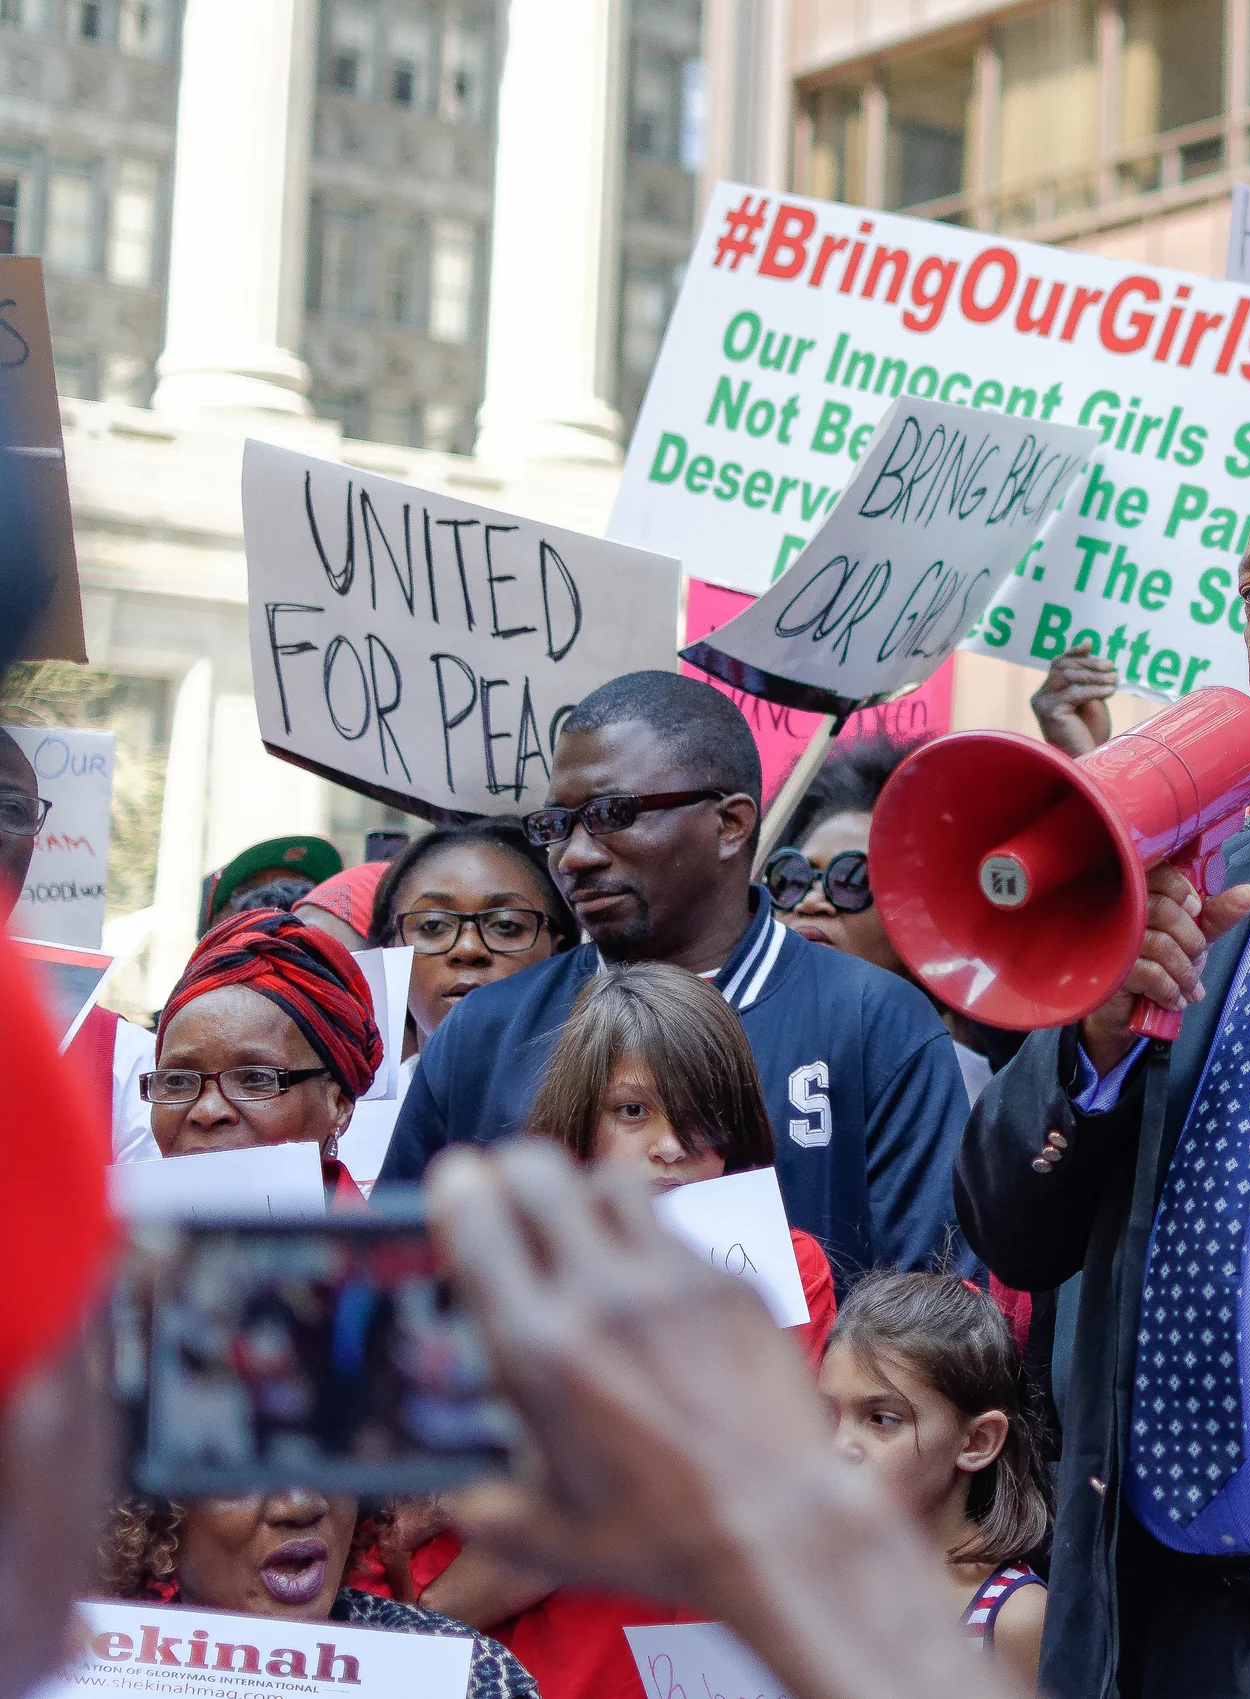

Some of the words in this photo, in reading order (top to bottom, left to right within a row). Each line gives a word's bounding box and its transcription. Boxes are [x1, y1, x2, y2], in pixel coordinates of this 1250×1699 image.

[705, 374, 800, 445] Not
[722, 310, 816, 375] Our
[823, 332, 1063, 419] Innocent
[1077, 389, 1208, 466] Girls
[648, 431, 841, 522] Deserv
[1074, 535, 1172, 611] The
[858, 416, 1000, 529] BRING
[306, 471, 582, 661] UNITED
[775, 555, 891, 667] OUR
[265, 602, 412, 784] FOR
[34, 736, 108, 779] OUR
[788, 1060, 832, 1148] S
[92, 1625, 361, 1685] ekinah
[126, 1667, 142, 1676] OF
[146, 1670, 216, 1683] GLORYMAG
[219, 1677, 319, 1694] INTERNATIONAL
